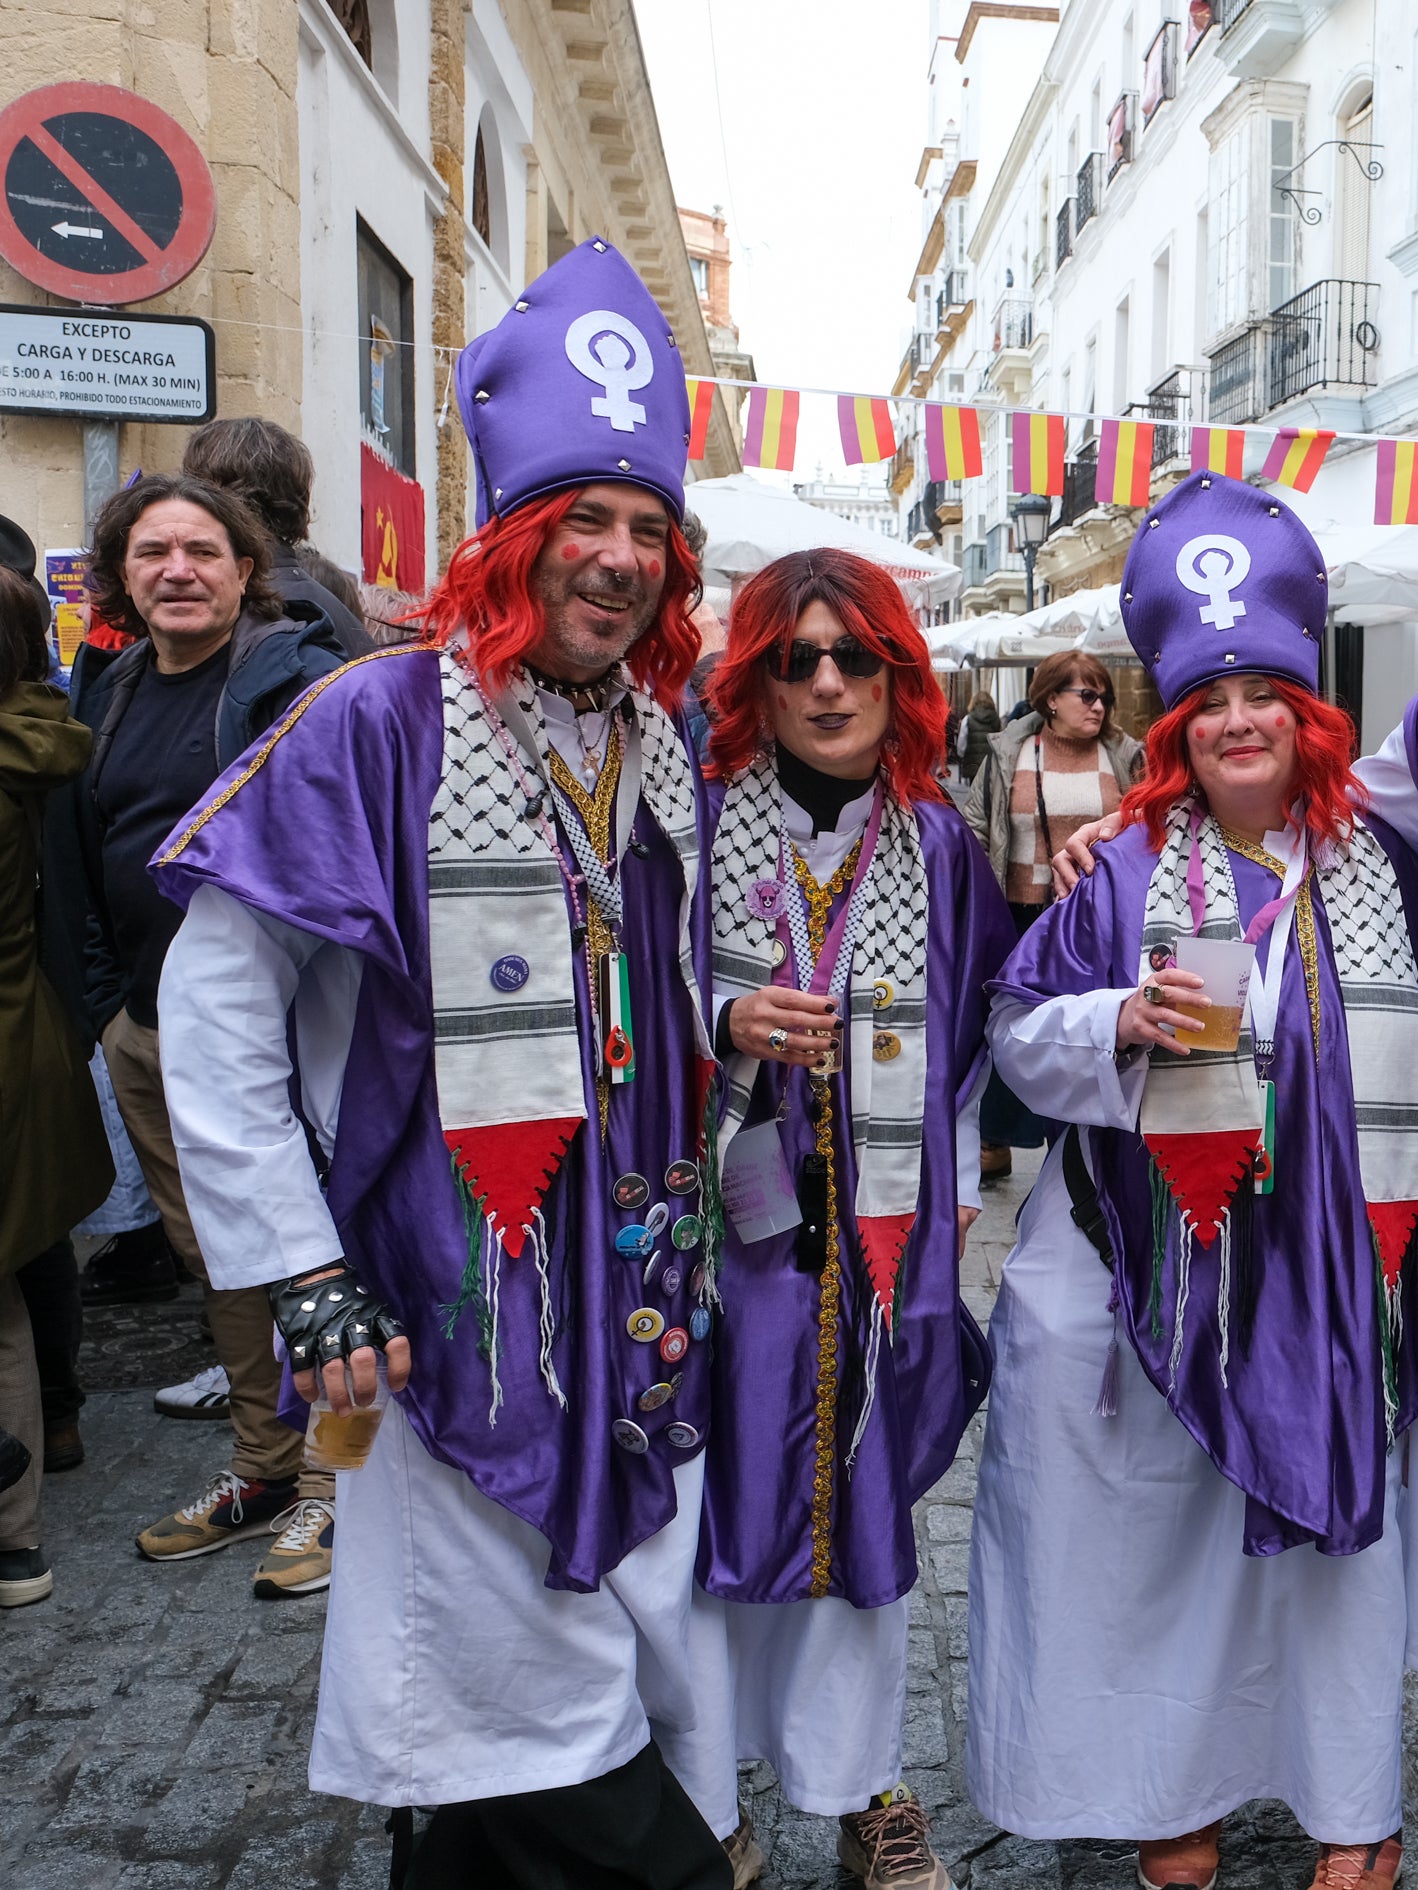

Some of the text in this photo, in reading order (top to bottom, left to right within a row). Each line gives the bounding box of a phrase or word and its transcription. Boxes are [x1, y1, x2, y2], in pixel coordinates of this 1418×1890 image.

[63, 322, 131, 340] EXCEPTO
[17, 343, 176, 367] CARGA Y DESCARGA
[0, 366, 201, 392] E 5:00 A 16:00 H. (MAX 30 MIN)
[59, 391, 103, 403] PROHIBIDO
[105, 393, 127, 405] TODO
[129, 395, 202, 410] ESTACIONAMIENTO
[498, 964, 522, 982] AMEN
